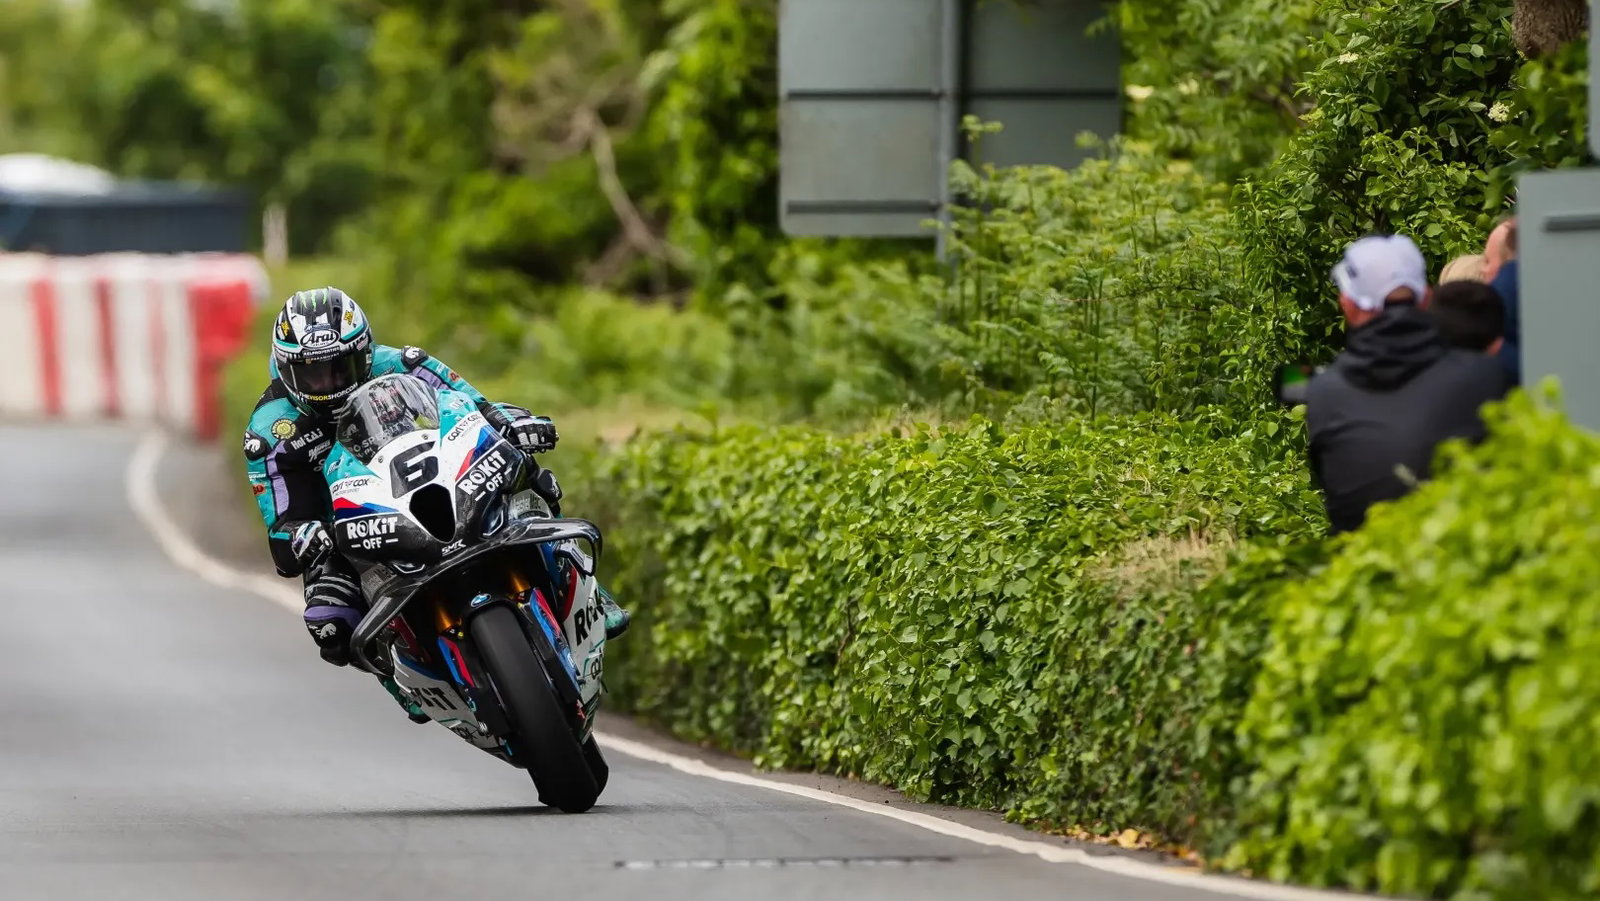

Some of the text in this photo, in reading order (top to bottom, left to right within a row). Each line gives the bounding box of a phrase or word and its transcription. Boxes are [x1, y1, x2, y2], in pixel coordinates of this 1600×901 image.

[306, 331, 335, 345] Arai
[389, 440, 439, 499] 6
[457, 449, 507, 495] ROKiT
[485, 472, 503, 492] OFF
[346, 516, 399, 539] ROKiT
[362, 537, 382, 550] OFF
